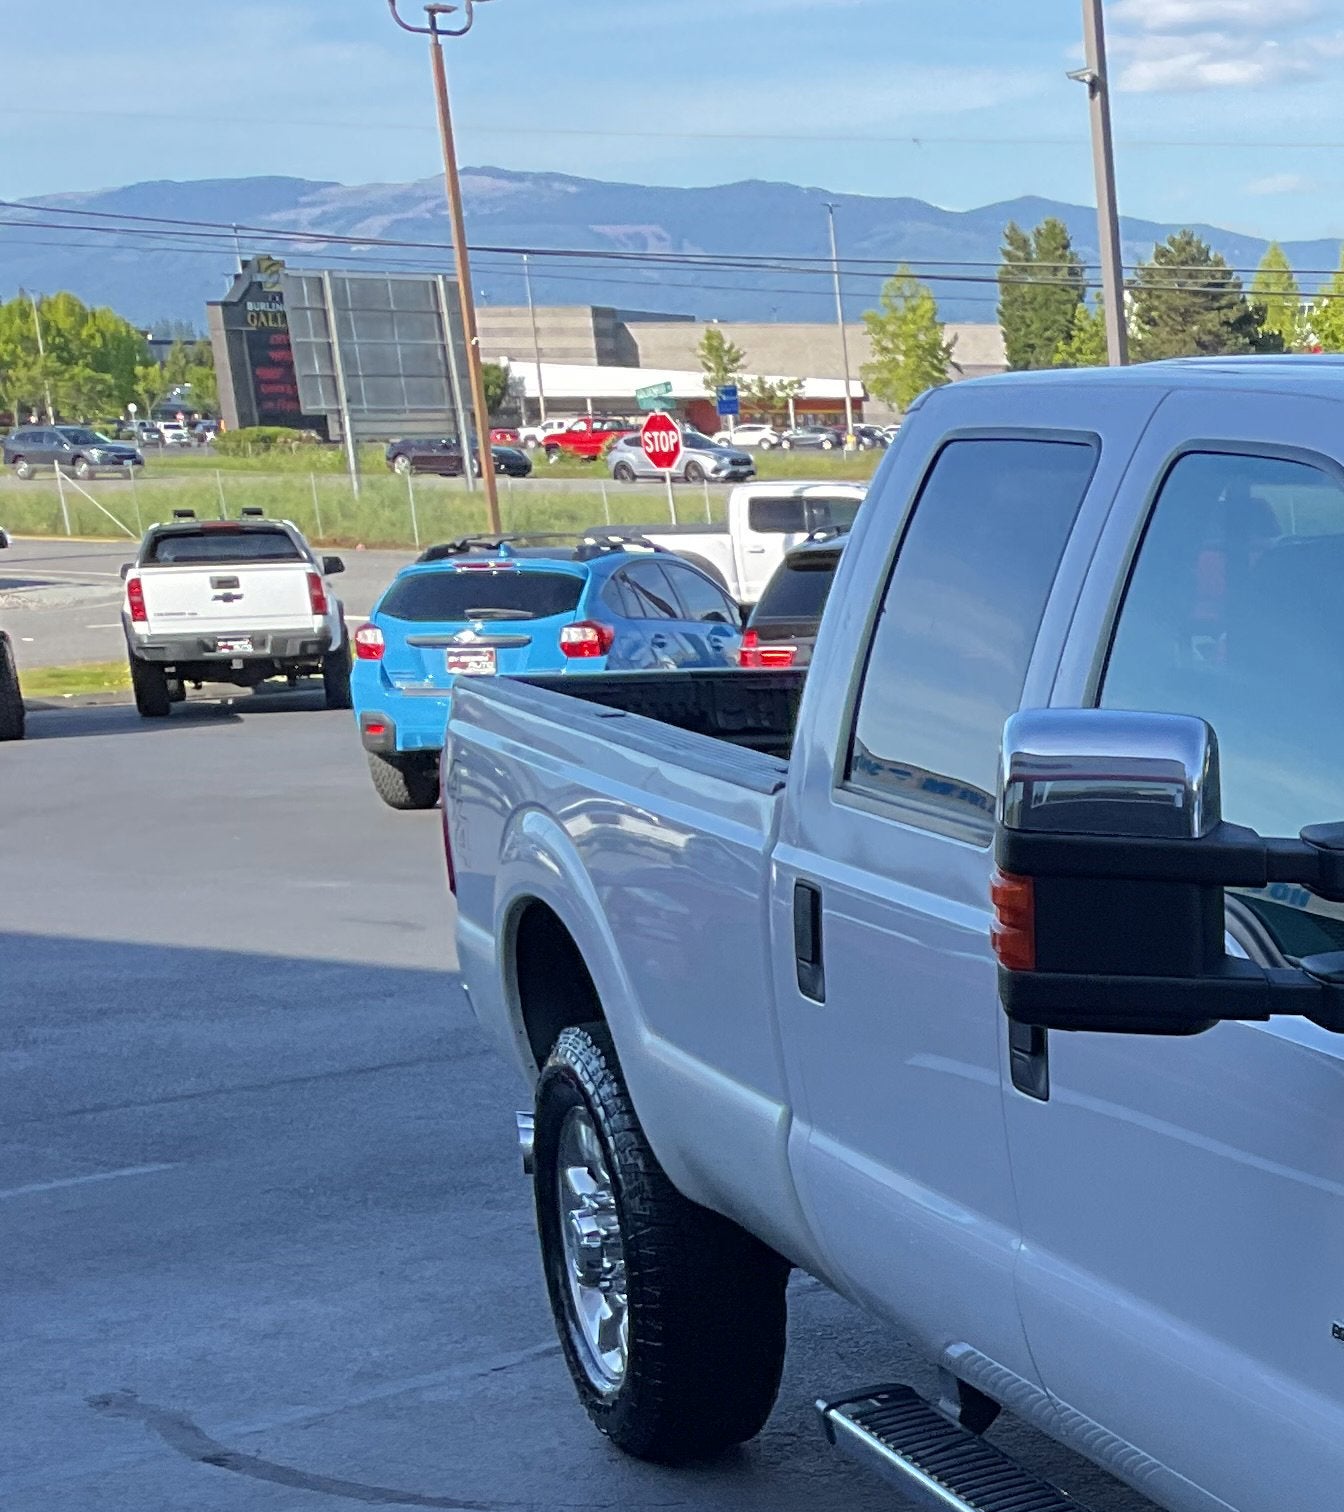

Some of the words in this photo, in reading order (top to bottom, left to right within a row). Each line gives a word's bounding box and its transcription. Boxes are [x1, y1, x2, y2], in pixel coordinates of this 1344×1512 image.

[246, 301, 284, 311] BURLIN
[247, 311, 286, 328] GALL
[643, 431, 678, 453] STOP
